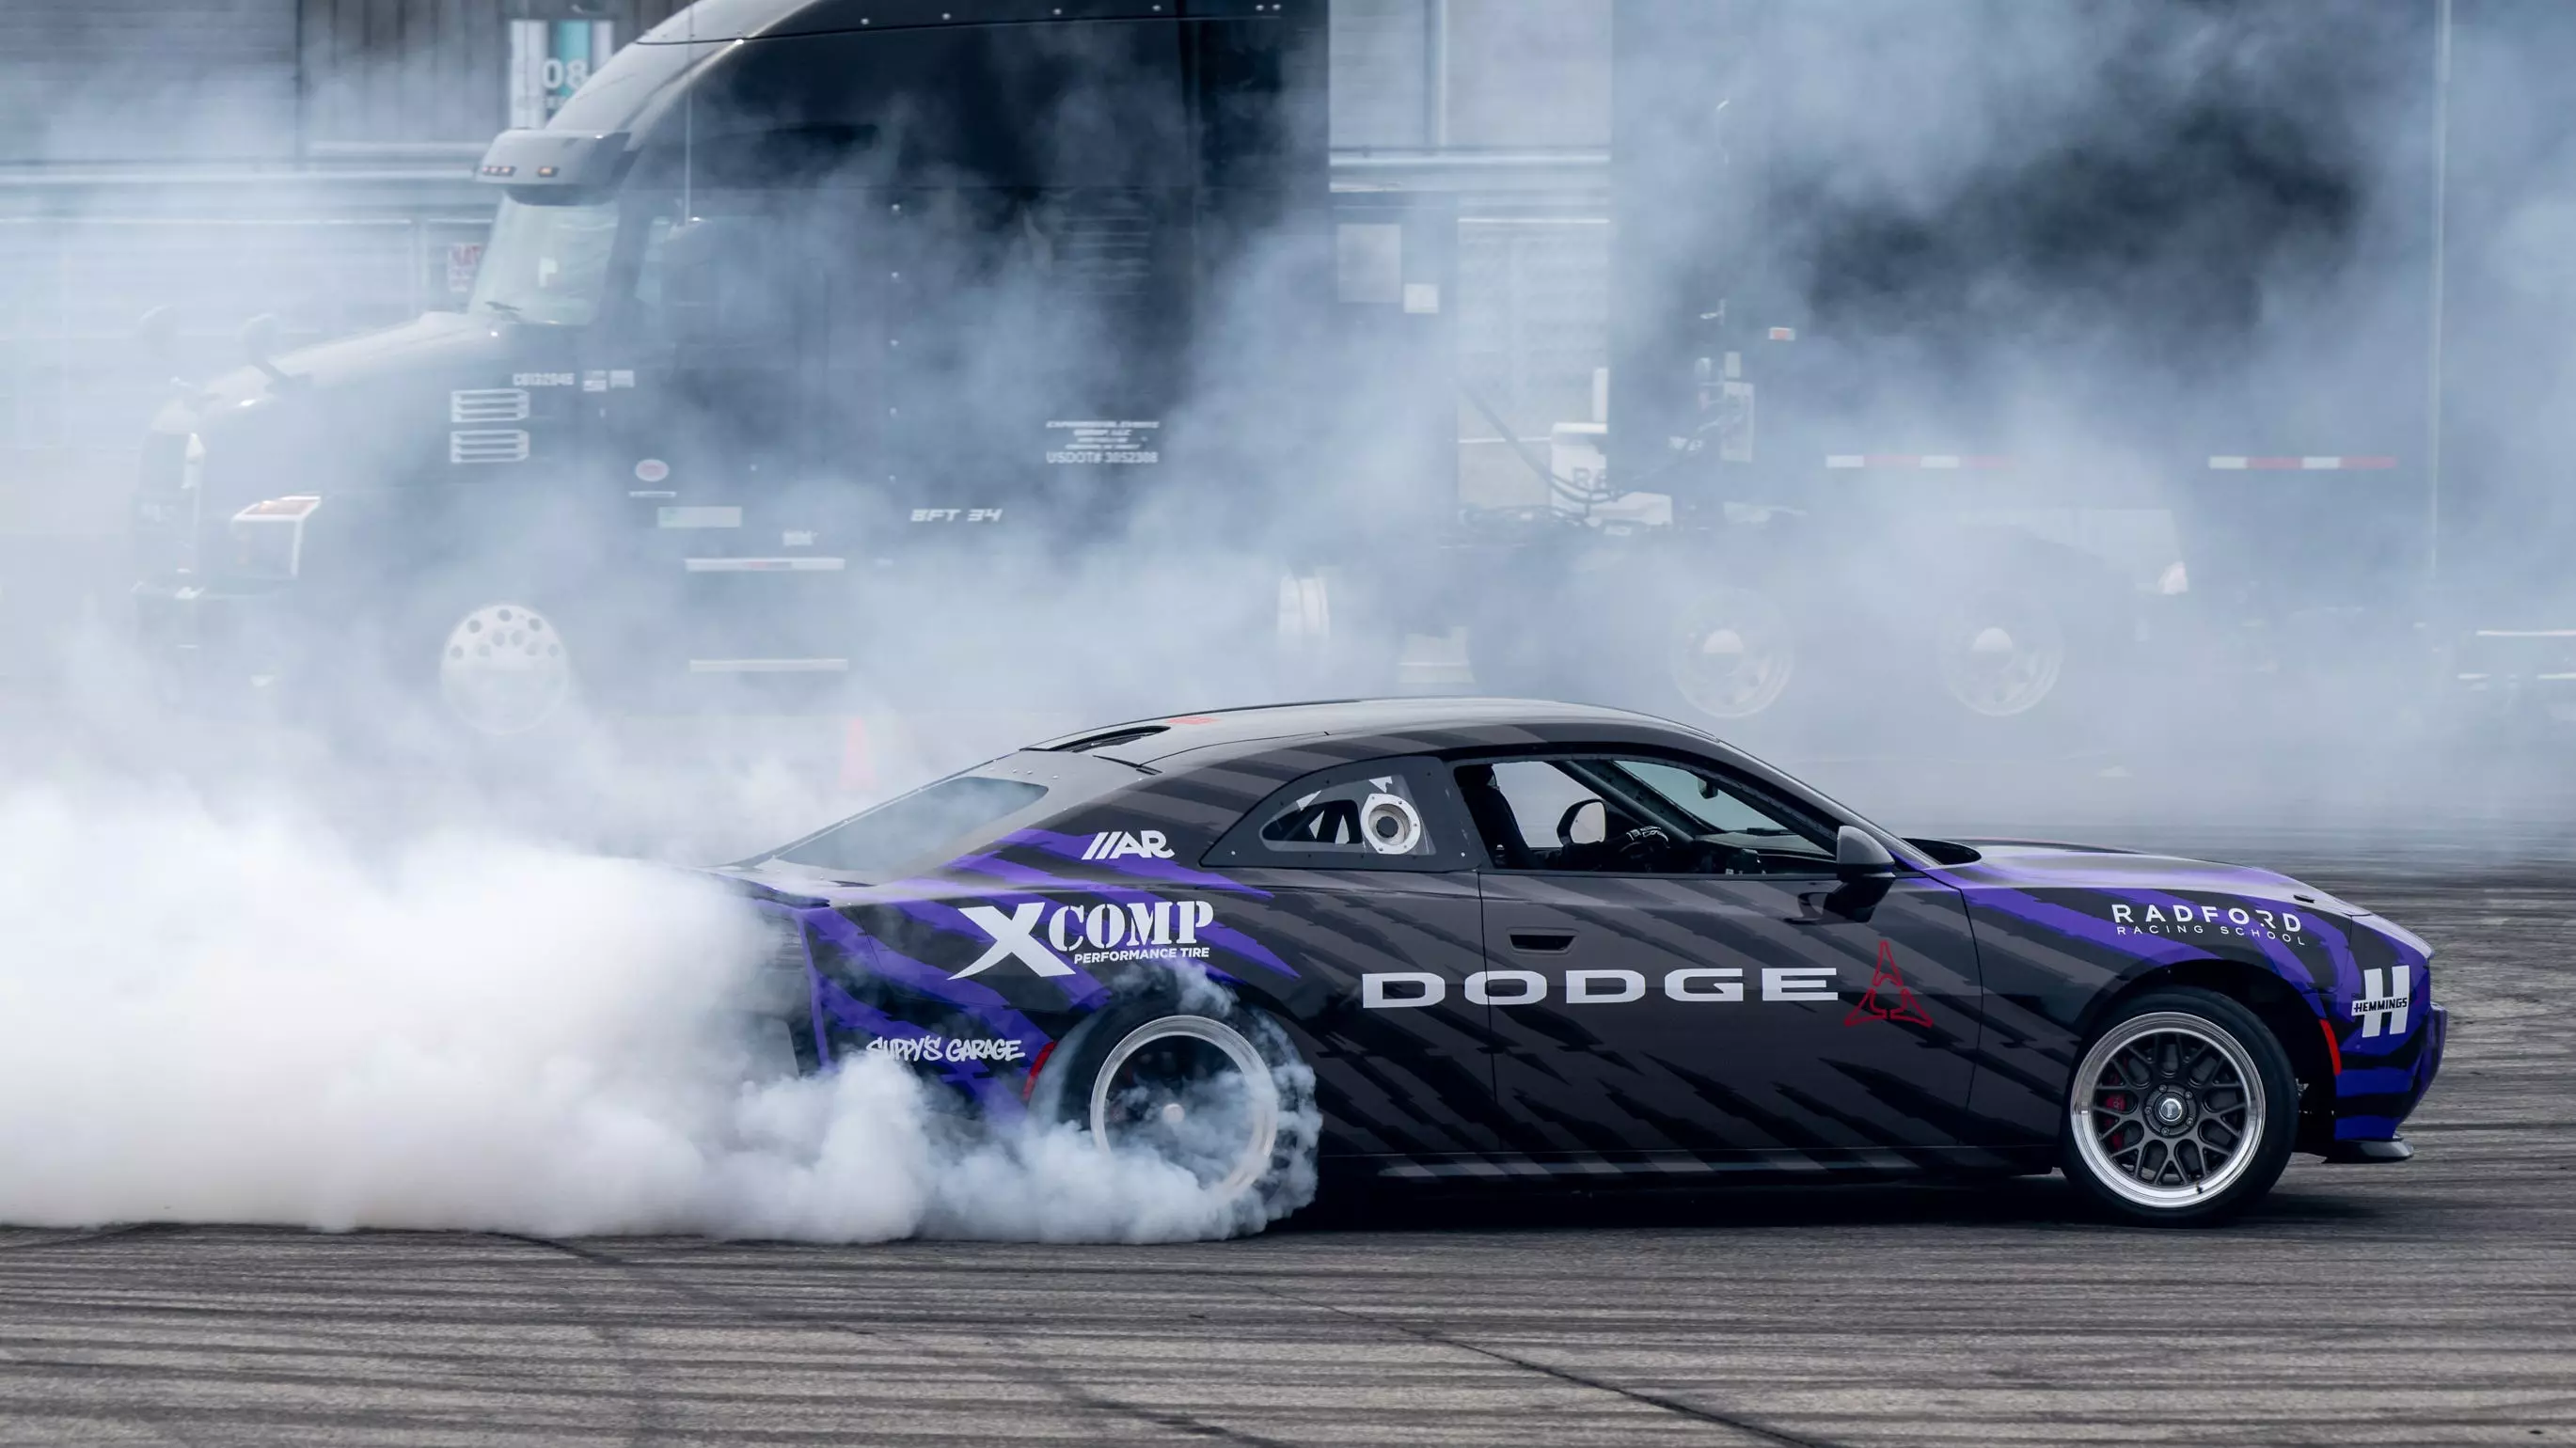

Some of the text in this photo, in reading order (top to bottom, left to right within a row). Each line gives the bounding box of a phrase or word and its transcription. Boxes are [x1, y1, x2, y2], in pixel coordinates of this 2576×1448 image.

[543, 57, 587, 90] 08
[967, 509, 1004, 522] 34
[2111, 904, 2301, 933] RADFORD
[2117, 924, 2306, 946] RACING SCHOOL
[1073, 947, 1210, 965] PERFORMANCE TIRE
[1362, 968, 1839, 1008] DODGE
[2353, 997, 2408, 1014] HEMMINGS
[945, 1039, 1026, 1062] GARAGE
